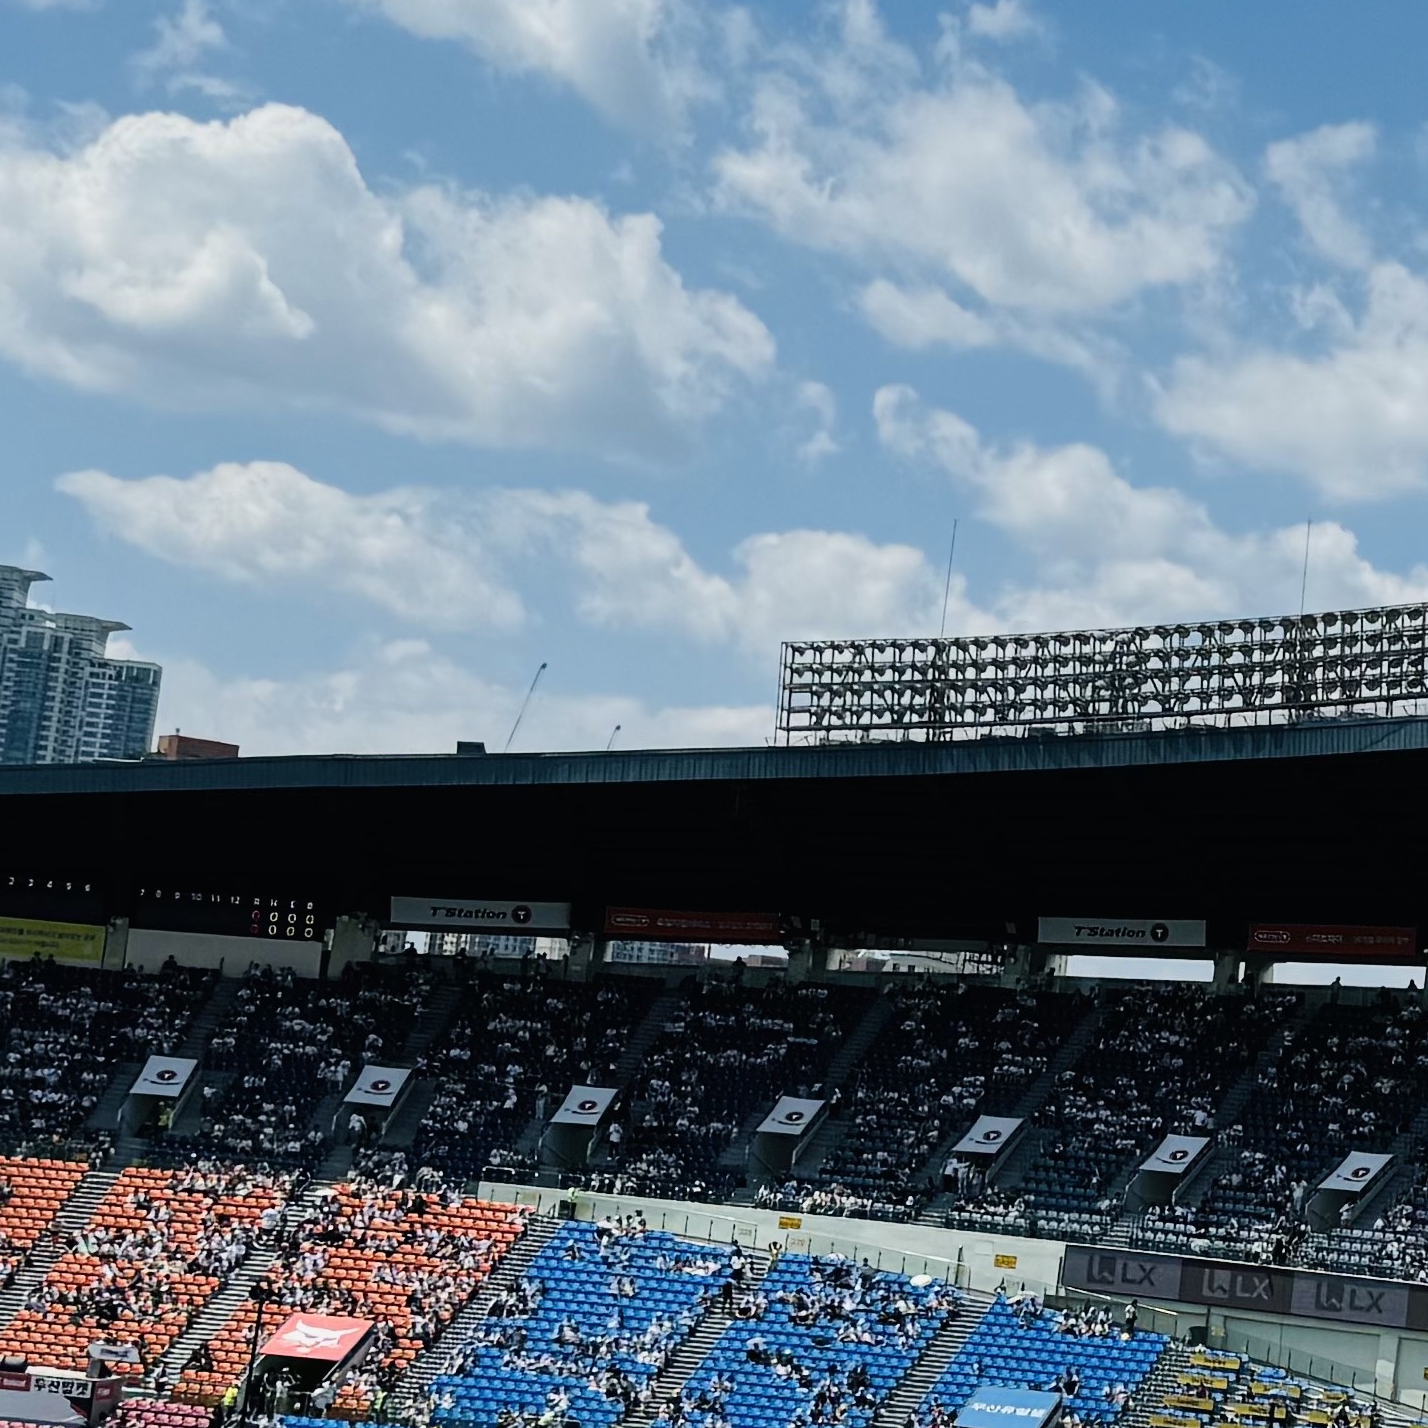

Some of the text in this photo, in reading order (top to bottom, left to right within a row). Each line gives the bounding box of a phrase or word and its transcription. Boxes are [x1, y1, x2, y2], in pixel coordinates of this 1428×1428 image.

[268, 924, 277, 935] 0
[286, 926, 295, 937] 0
[304, 927, 314, 938] 0
[269, 911, 279, 922] 0
[287, 913, 297, 924] 0
[305, 914, 315, 925] 0
[1121, 1259, 1157, 1287] LX
[1236, 1273, 1269, 1301] LX
[1350, 1288, 1384, 1315] LX
